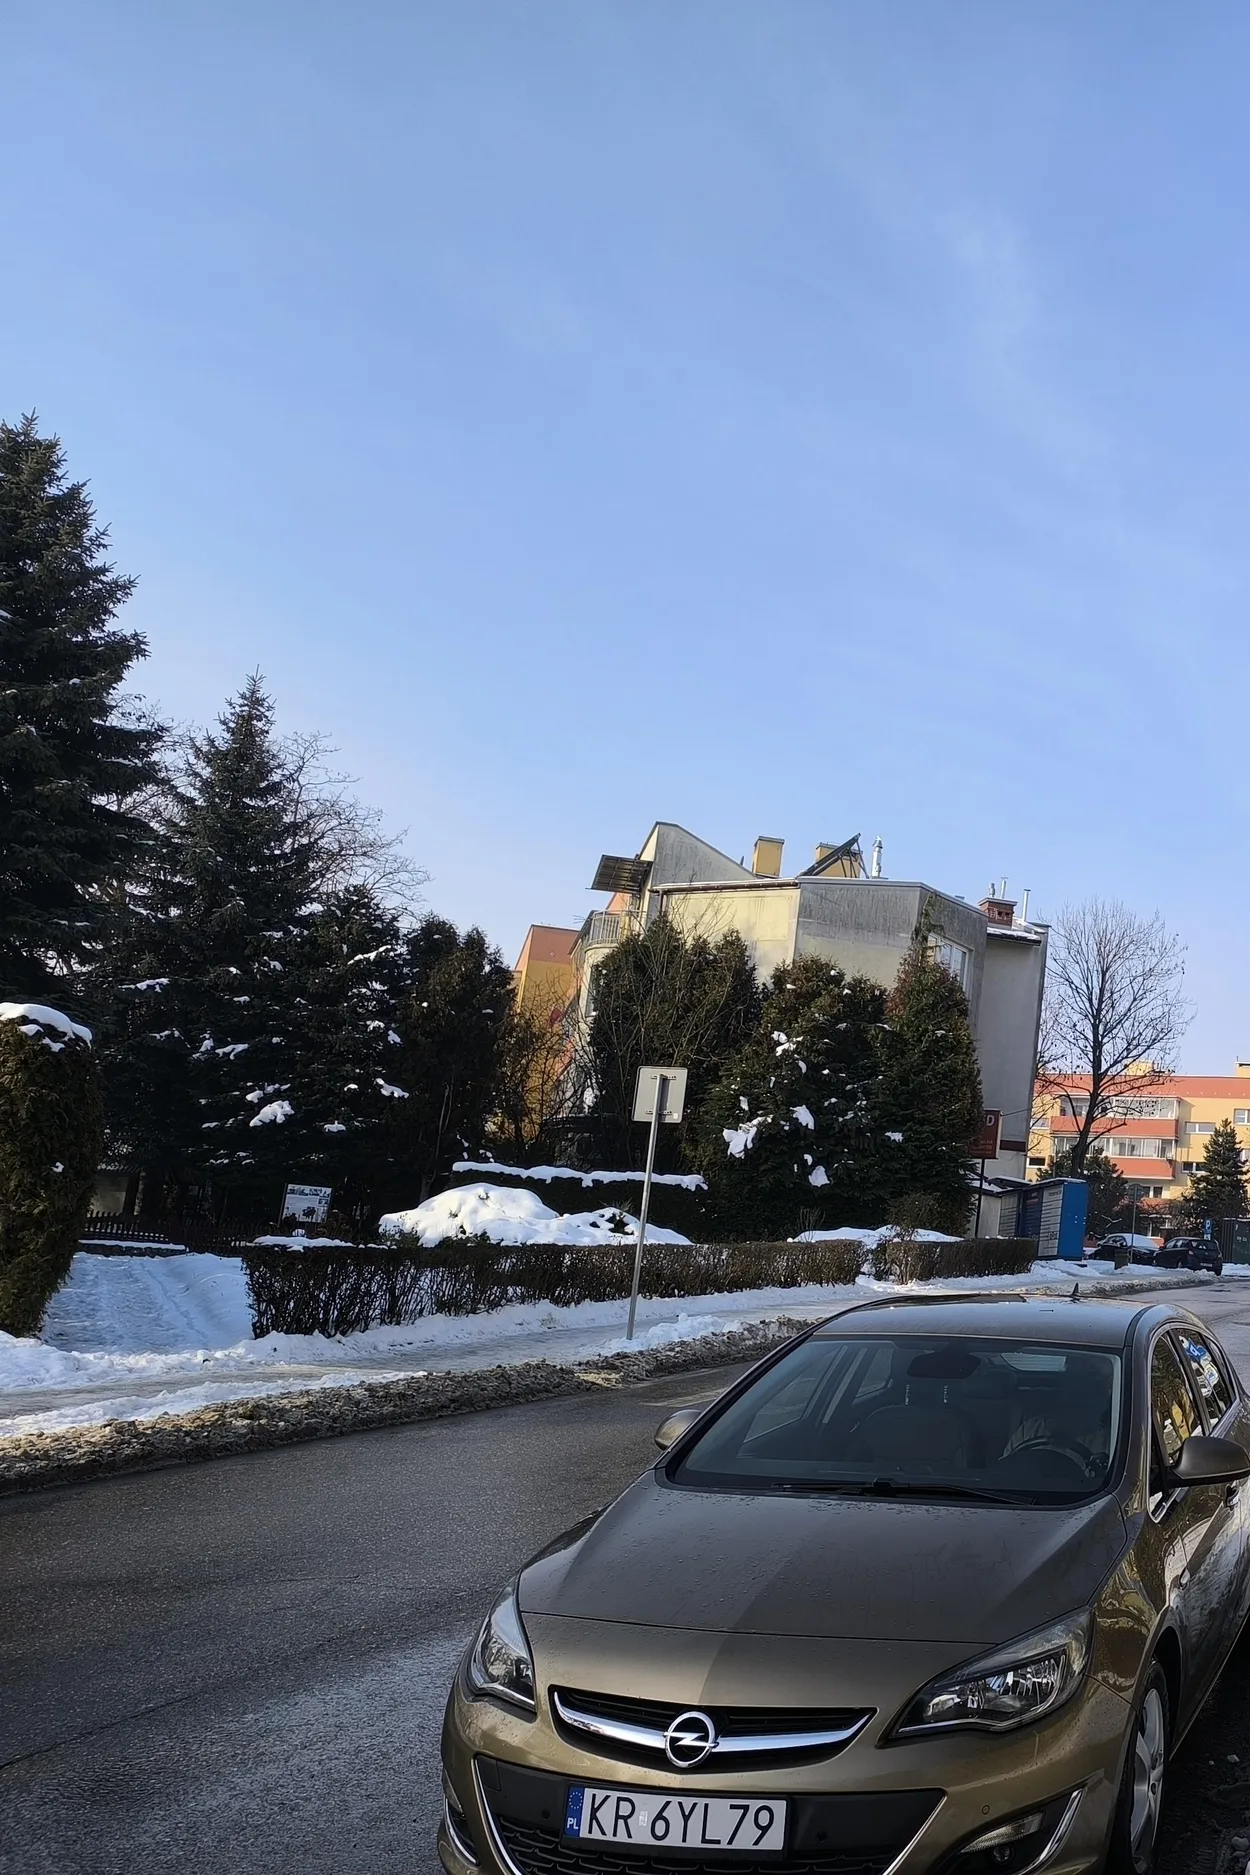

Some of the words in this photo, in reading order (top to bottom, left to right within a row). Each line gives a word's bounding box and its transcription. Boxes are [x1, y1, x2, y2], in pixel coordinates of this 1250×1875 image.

[567, 1817, 579, 1830] PL
[588, 1793, 636, 1839] KR
[651, 1800, 775, 1846] 6YL79
